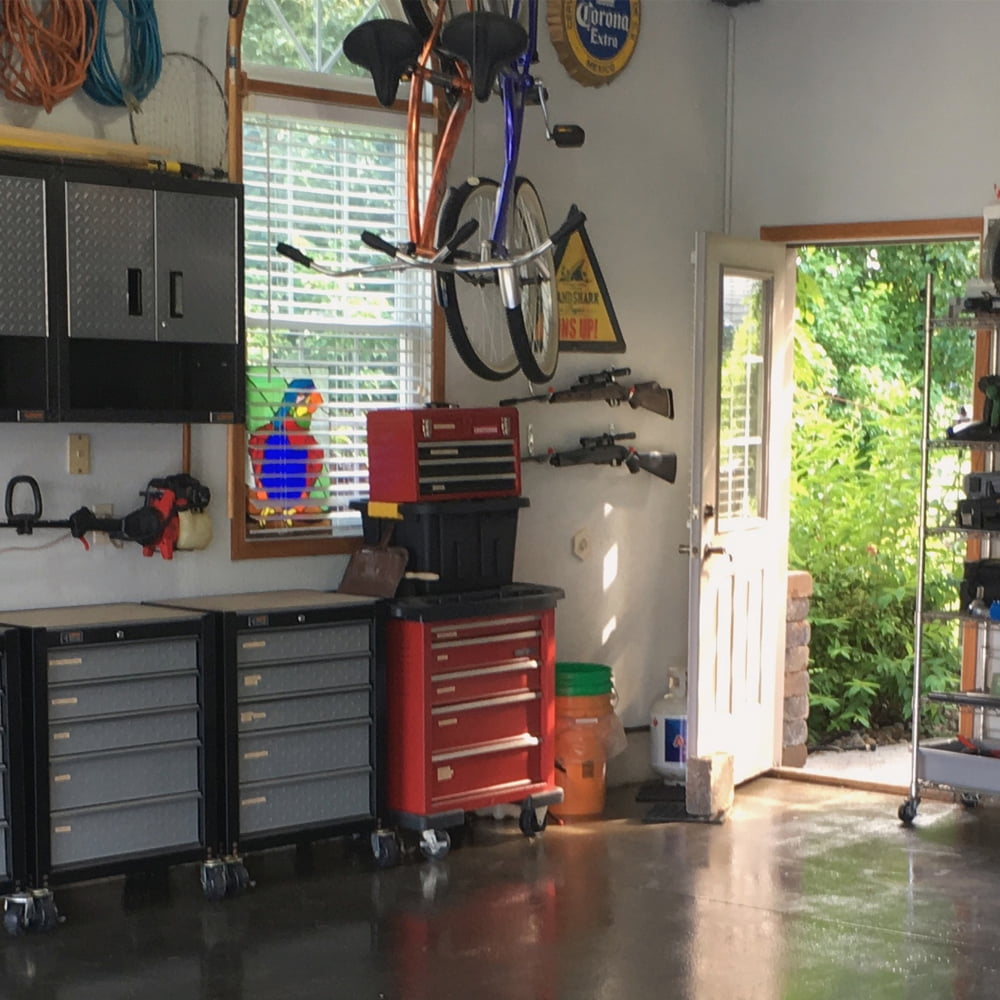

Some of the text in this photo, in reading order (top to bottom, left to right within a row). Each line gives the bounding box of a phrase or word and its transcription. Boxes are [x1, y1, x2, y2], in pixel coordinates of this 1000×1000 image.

[576, 1, 629, 32] Corona
[590, 26, 618, 48] Extra
[557, 291, 599, 304] ANDSHARK
[559, 317, 598, 340] NS UP!
